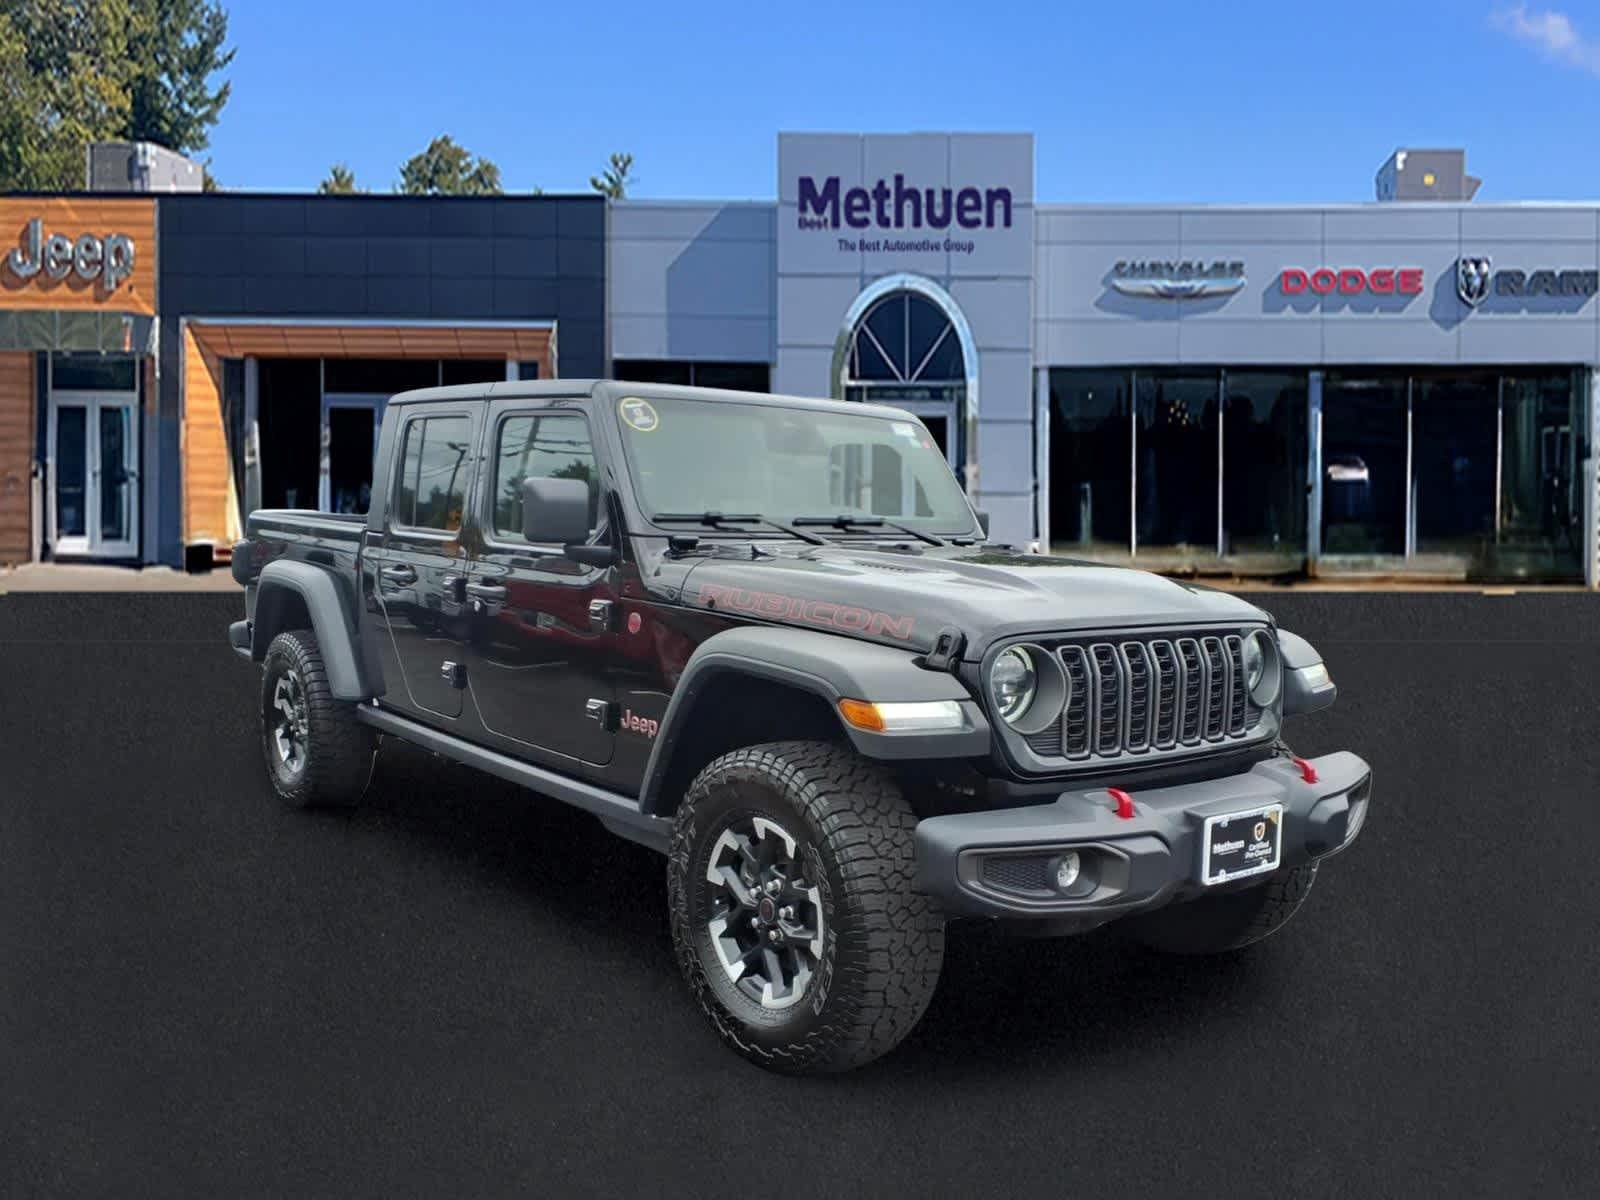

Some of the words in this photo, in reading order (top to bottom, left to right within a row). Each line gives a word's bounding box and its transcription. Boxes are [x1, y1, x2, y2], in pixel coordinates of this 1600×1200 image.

[798, 173, 1013, 229] Methuen
[8, 218, 136, 290] Jeep
[838, 239, 857, 252] The
[859, 239, 881, 252] Best
[883, 239, 941, 252] Automotive
[943, 239, 975, 254] Group
[1114, 260, 1245, 278] CHRYSLER
[1281, 268, 1424, 295] DODGE
[1495, 269, 1599, 297] RAM
[699, 583, 916, 640] RUBICON
[620, 709, 658, 738] Jeep
